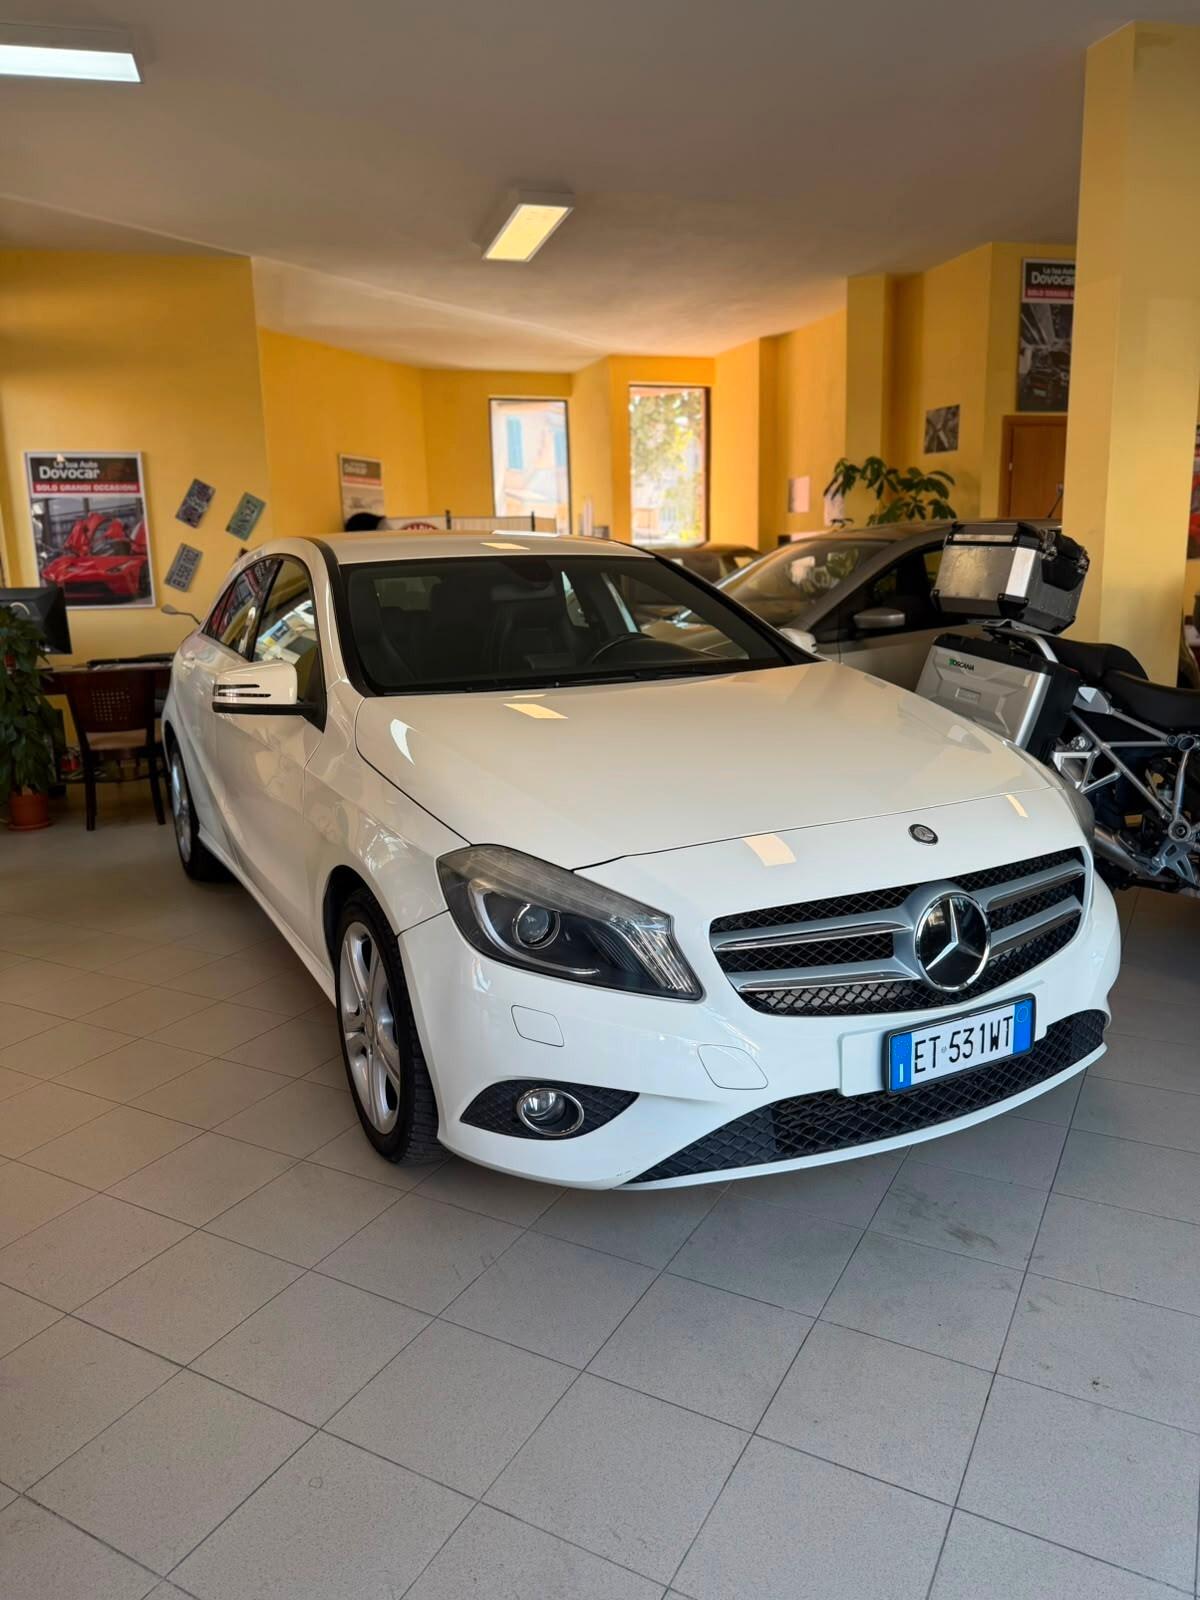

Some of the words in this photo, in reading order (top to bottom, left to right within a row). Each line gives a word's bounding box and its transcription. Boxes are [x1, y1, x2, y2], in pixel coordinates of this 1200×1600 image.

[80, 461, 98, 469] Auto
[39, 466, 100, 479] Dovocar
[948, 658, 975, 671] TOSCANA
[914, 1036, 941, 1074] ET
[949, 1015, 1013, 1063] 531WT
